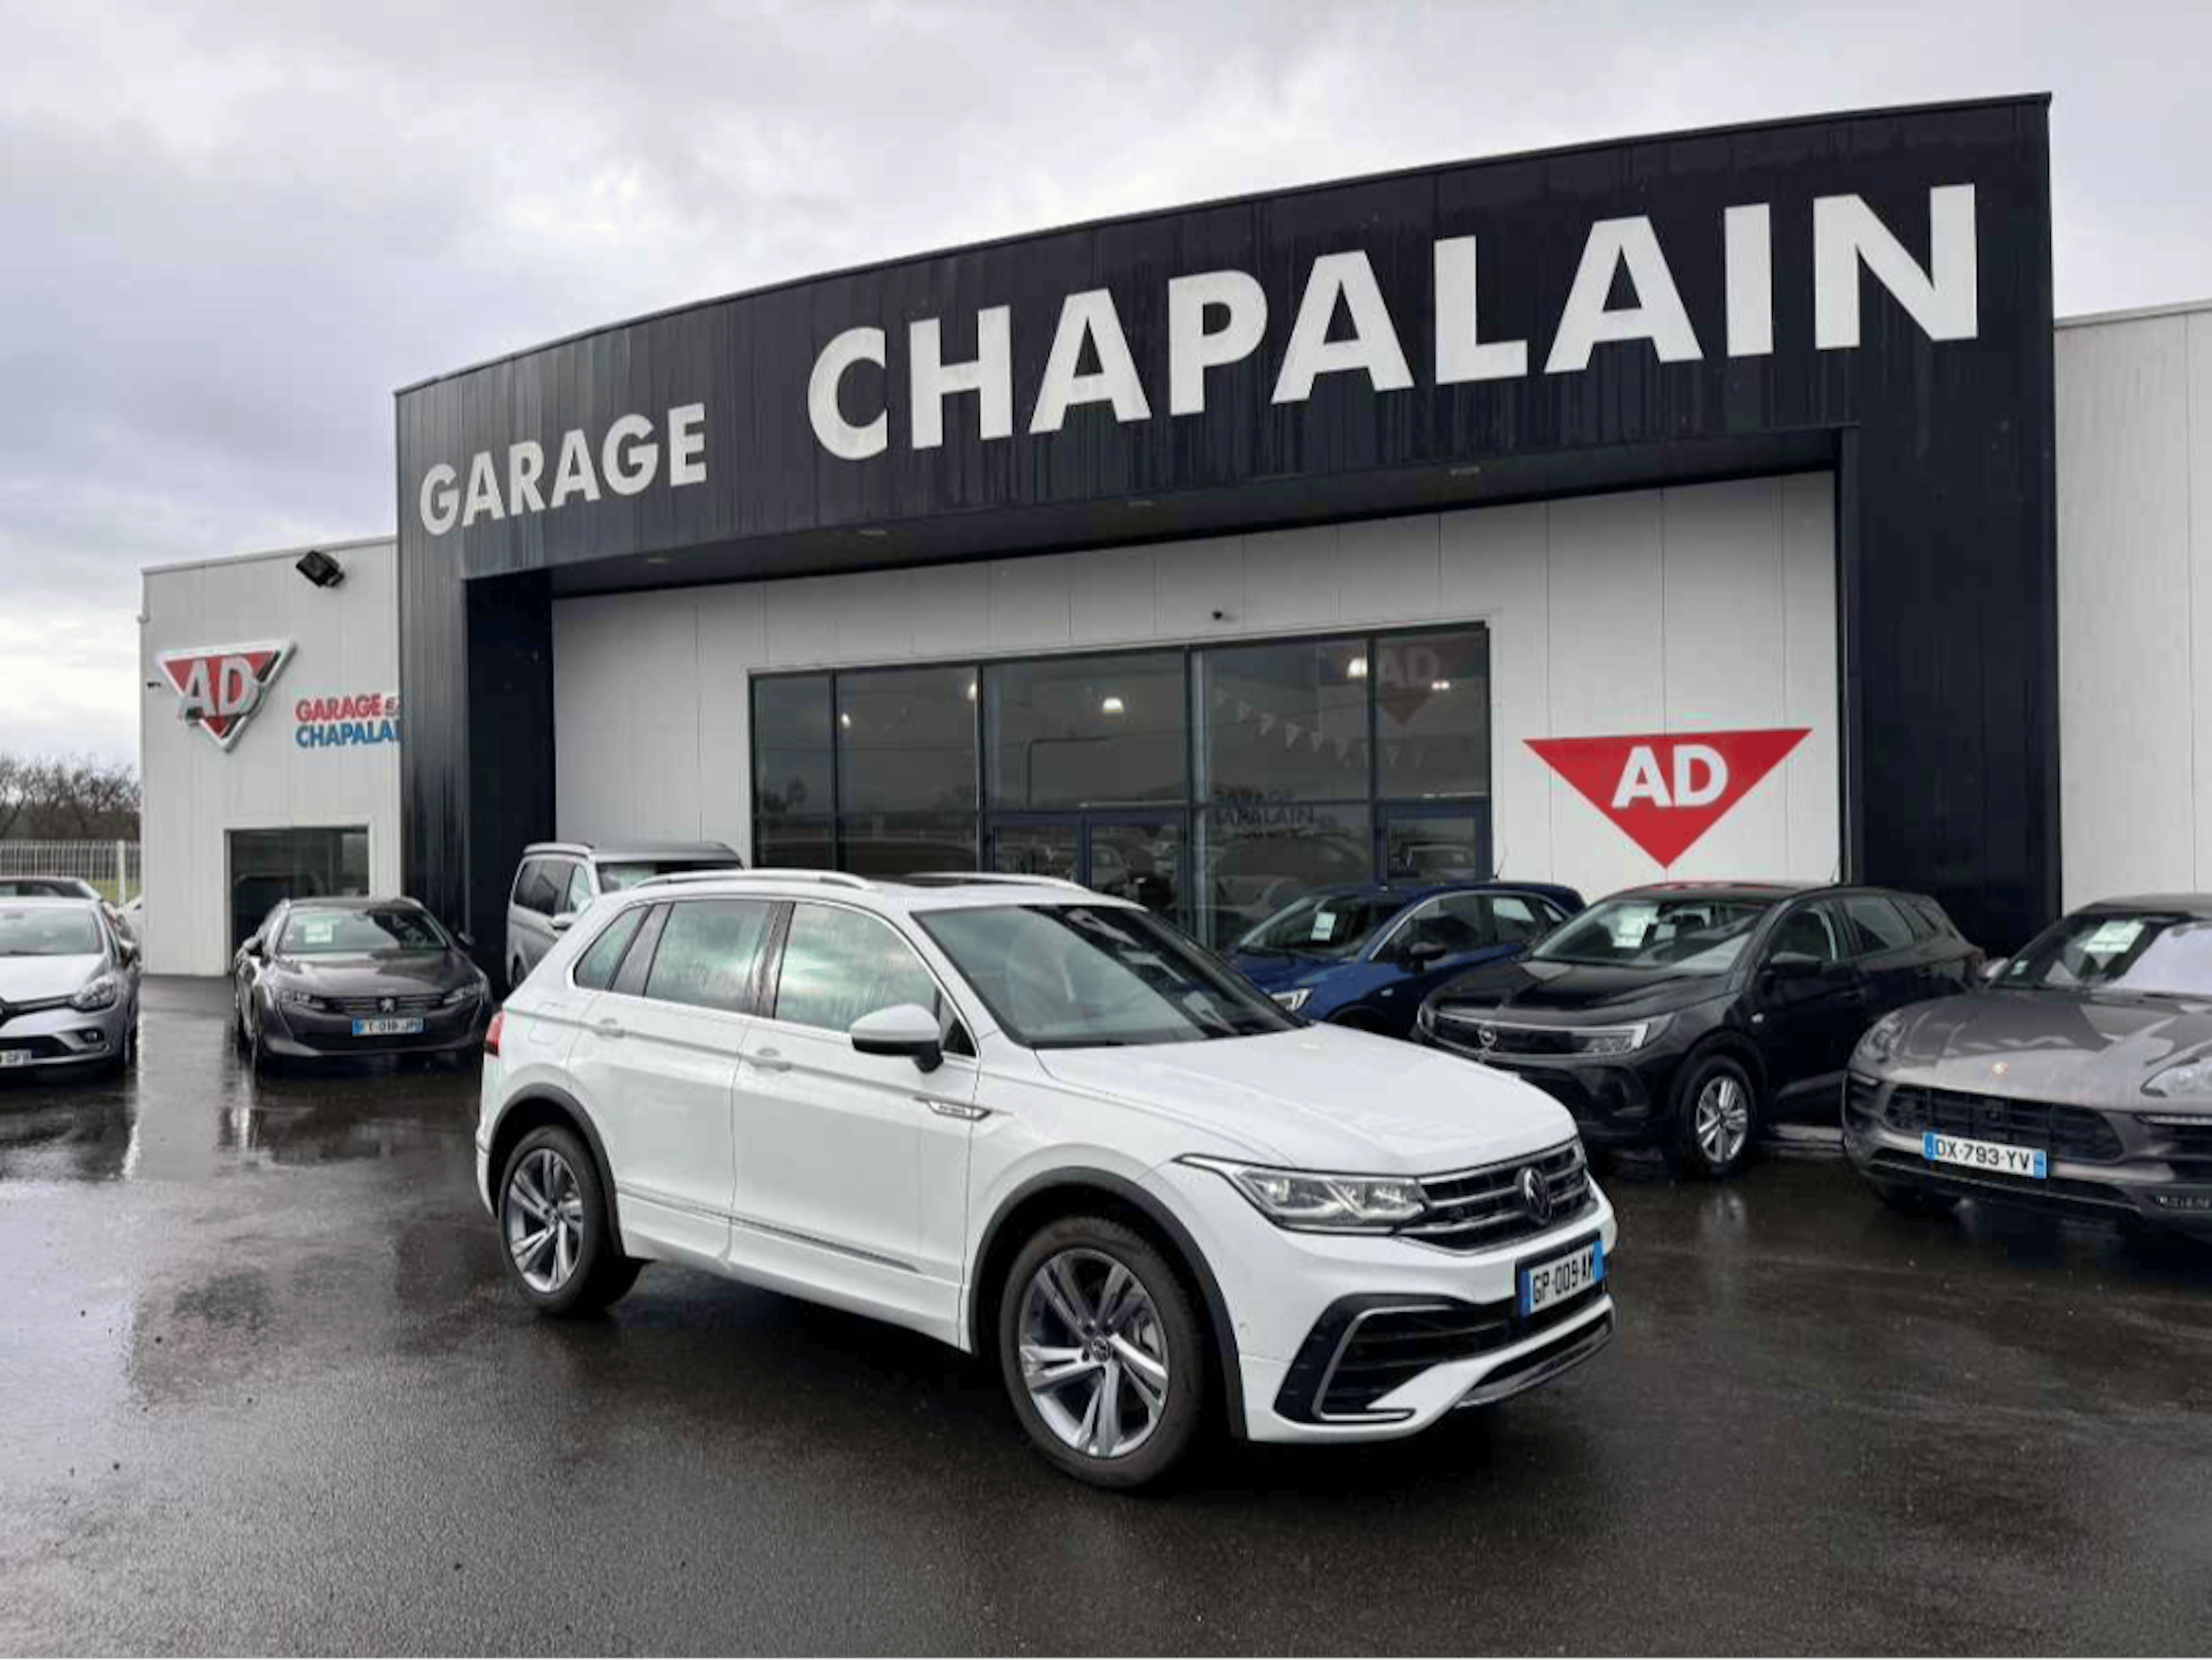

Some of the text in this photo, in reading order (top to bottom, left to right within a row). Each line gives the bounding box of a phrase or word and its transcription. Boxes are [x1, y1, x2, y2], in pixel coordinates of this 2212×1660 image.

[420, 184, 1978, 535] GARAGE CHAPALAIN
[175, 657, 259, 723] AD
[296, 693, 381, 722] GARAGE
[1612, 744, 1728, 808] AD
[1936, 1138, 2030, 1170] DX-793-YV
